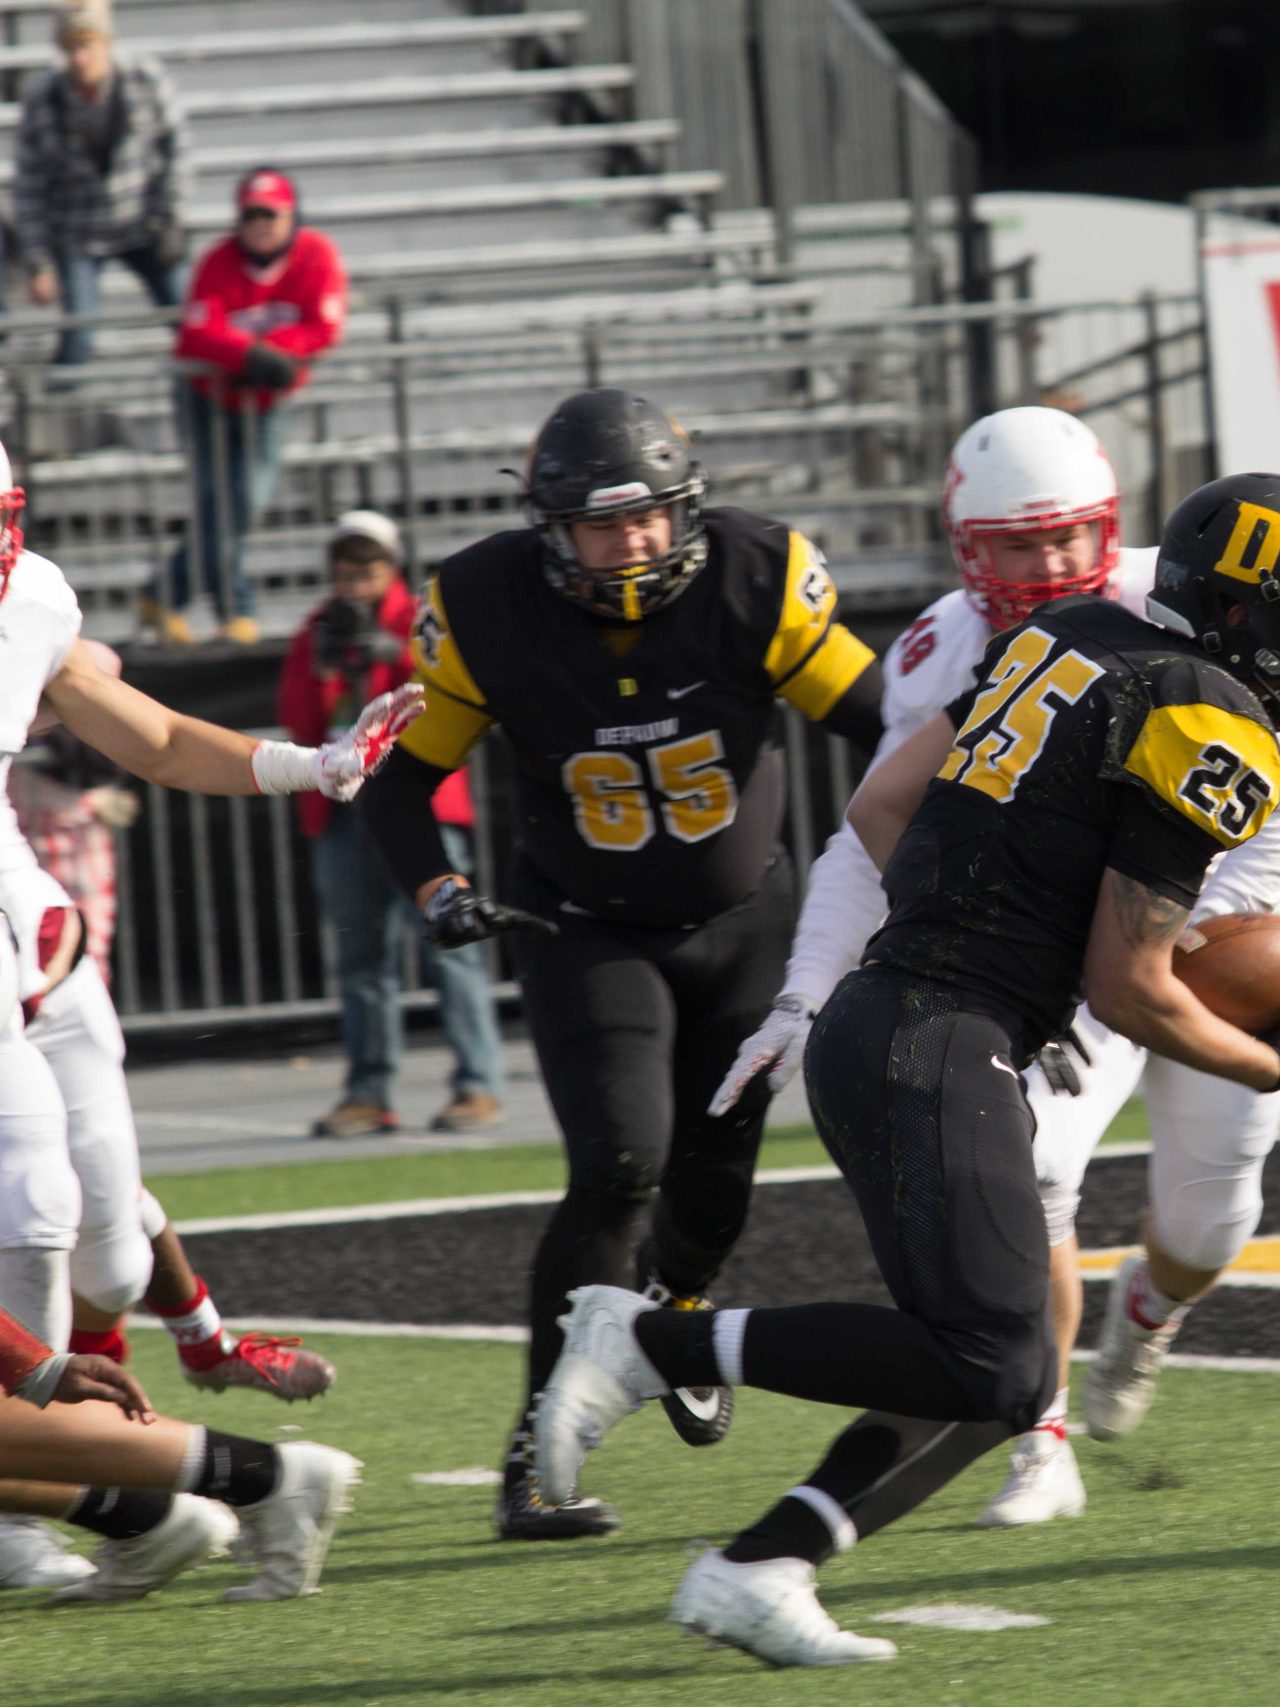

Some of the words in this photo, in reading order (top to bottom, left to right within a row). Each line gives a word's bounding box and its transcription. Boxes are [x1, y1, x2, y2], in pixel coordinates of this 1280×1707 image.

[935, 626, 1106, 804] 25
[561, 730, 738, 851] 65
[1176, 738, 1274, 841] 25
